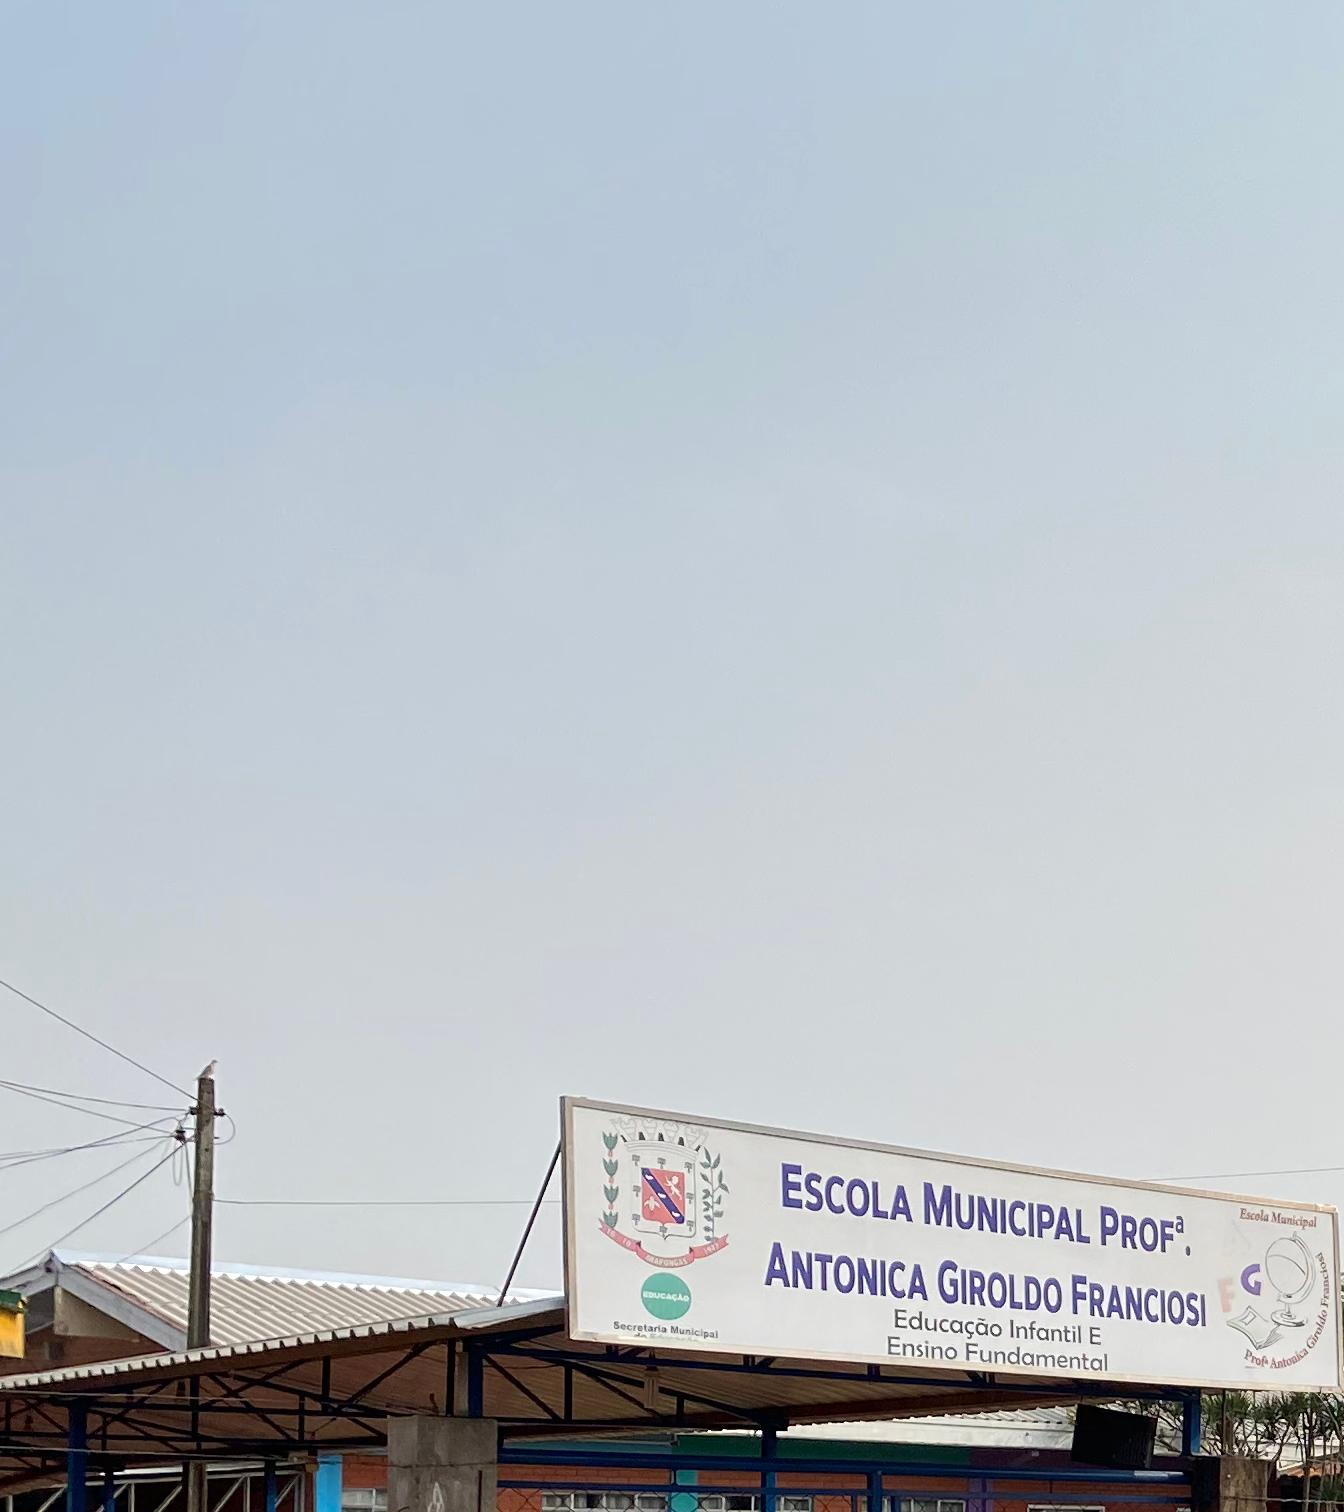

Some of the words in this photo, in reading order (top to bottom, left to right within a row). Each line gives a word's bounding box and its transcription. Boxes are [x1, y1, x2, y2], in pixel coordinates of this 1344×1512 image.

[782, 1162, 913, 1223] ESCOLA
[923, 1182, 1091, 1245] MUNICIPAL
[1239, 1208, 1269, 1223] Escola
[1271, 1211, 1317, 1230] Municipal
[642, 1290, 690, 1302] EDUCAÇÃO
[765, 1242, 928, 1301] ANTONICA
[938, 1259, 1063, 1314] GIROLDO
[1072, 1274, 1207, 1327] FRANCIOSI
[1316, 1251, 1330, 1309] Franciosi
[613, 1321, 667, 1334] Secretaria
[671, 1325, 719, 1339] Municipal
[894, 1308, 1002, 1339] Educação
[1010, 1319, 1082, 1344] Infantil
[1090, 1327, 1102, 1345] E
[1306, 1310, 1328, 1349] Giroldo
[887, 1336, 957, 1361] Ensino
[966, 1342, 1108, 1372] Fundamental
[1270, 1347, 1309, 1370] Antonica
